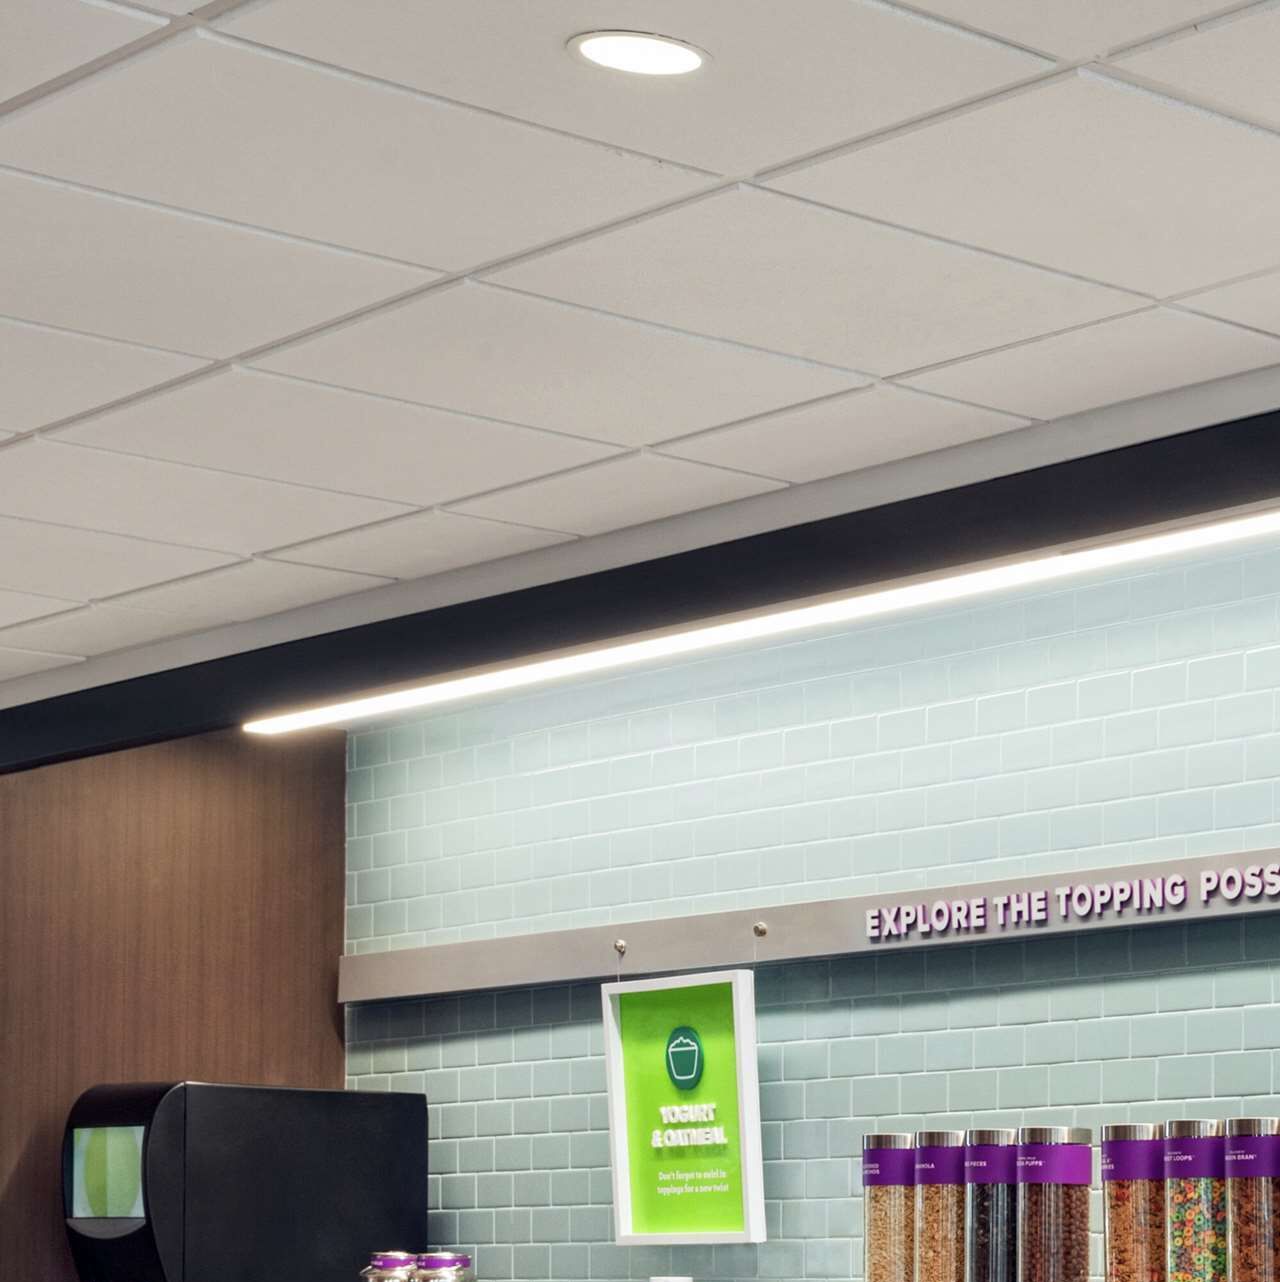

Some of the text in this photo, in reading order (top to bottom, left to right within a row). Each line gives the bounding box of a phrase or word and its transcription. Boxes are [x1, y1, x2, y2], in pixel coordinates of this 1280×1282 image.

[865, 898, 988, 938] EXPLORE
[993, 890, 1049, 927] THE
[1056, 873, 1189, 918] TOPPING
[659, 1103, 717, 1124] YOGURT
